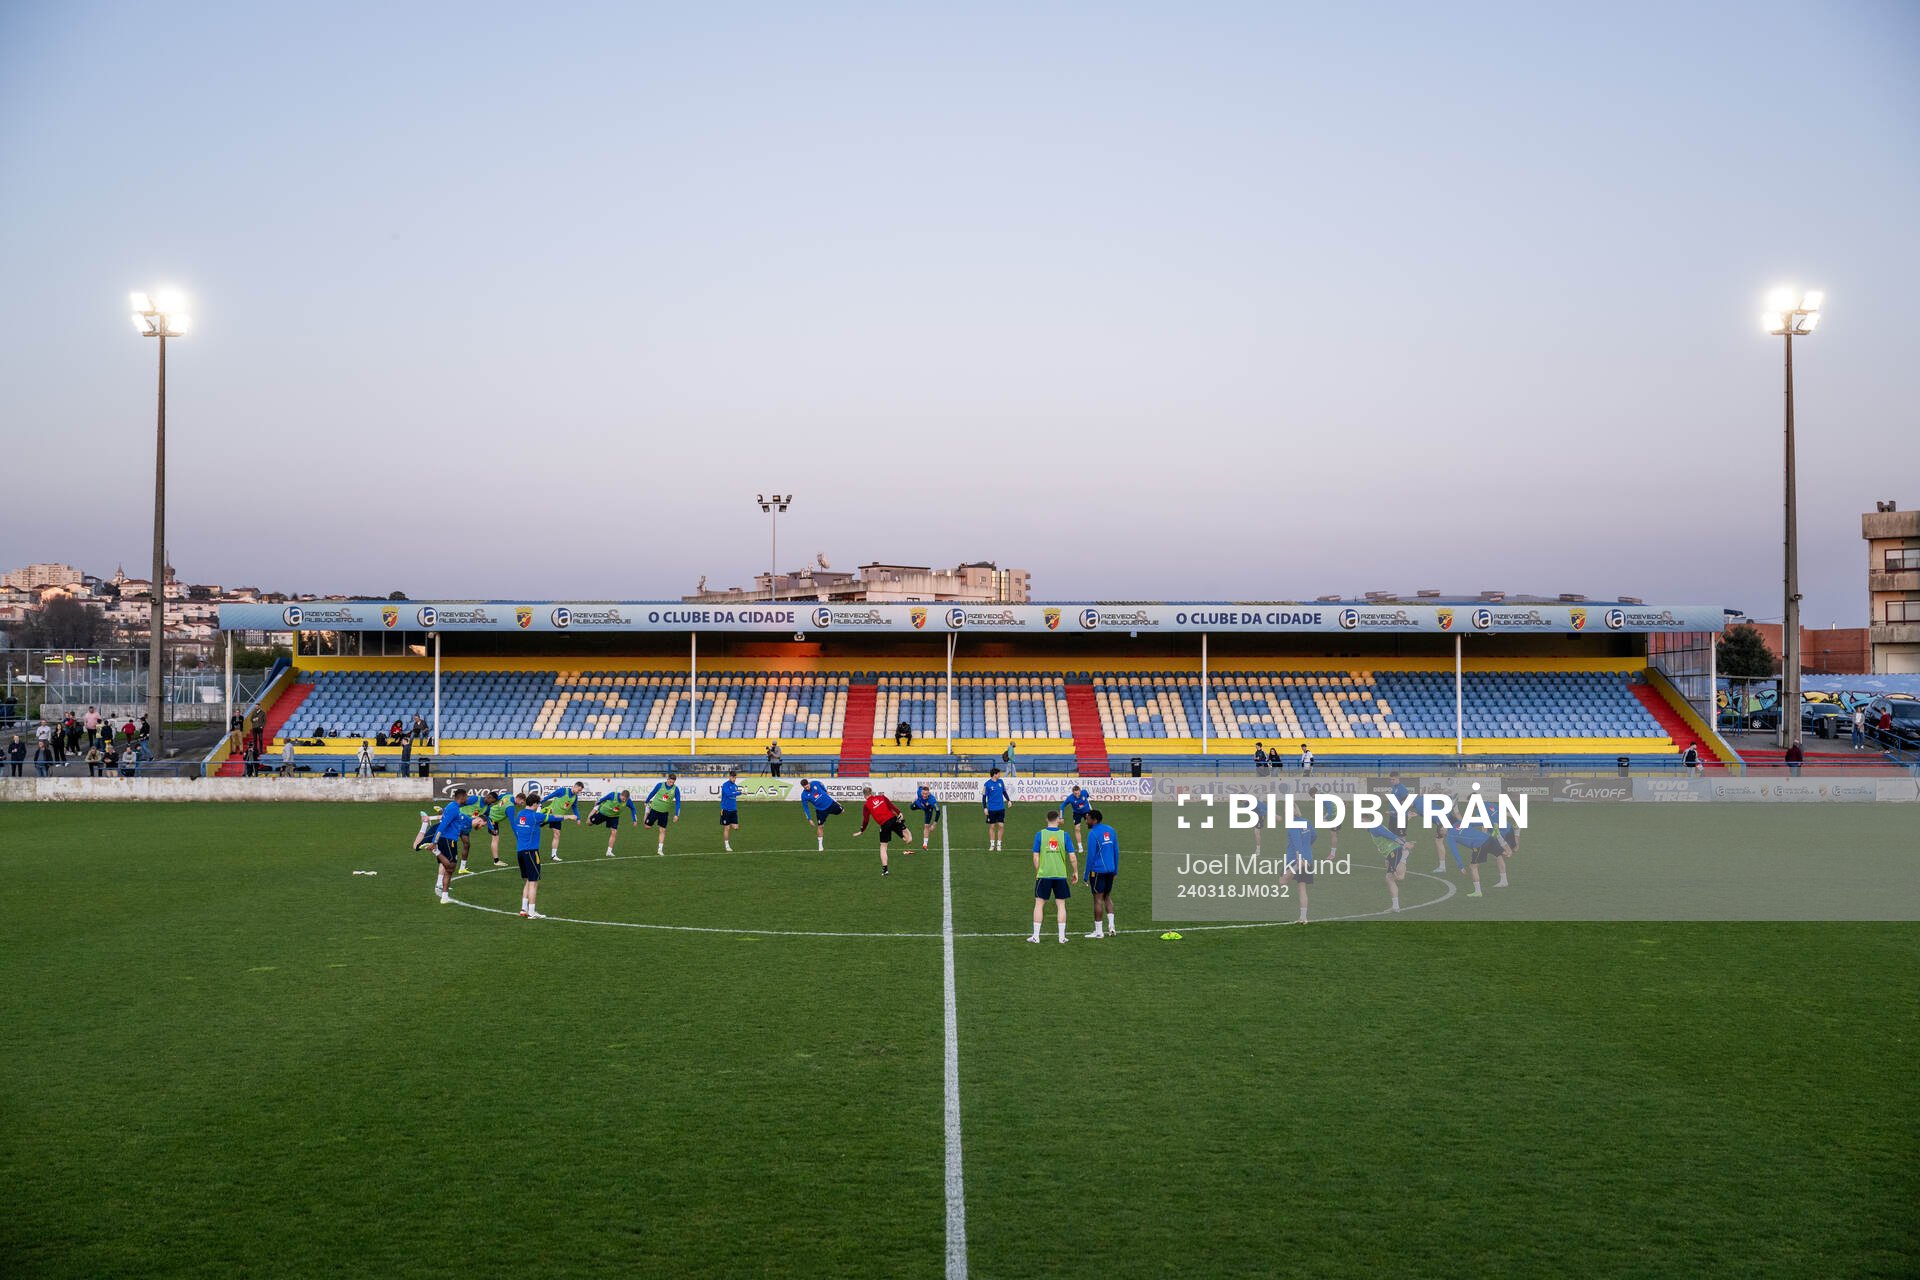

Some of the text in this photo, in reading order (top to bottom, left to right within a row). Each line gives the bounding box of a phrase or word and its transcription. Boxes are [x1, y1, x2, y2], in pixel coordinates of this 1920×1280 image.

[648, 612, 795, 624] O CLUBE DA CIDADE
[1176, 613, 1322, 625] O CLUBE DA CIDADE
[943, 781, 951, 790] DE
[951, 781, 979, 790] GONDOMAR
[1026, 778, 1058, 786] UNIÃO
[1647, 780, 1689, 791] TOYO
[1017, 786, 1026, 794] DE
[1026, 786, 1059, 794] GONDOMAR
[1091, 786, 1116, 794] VALBOM
[1569, 788, 1627, 799] PLAYOFF
[945, 791, 975, 801] DESPORTO
[1653, 791, 1700, 801] TIRES
